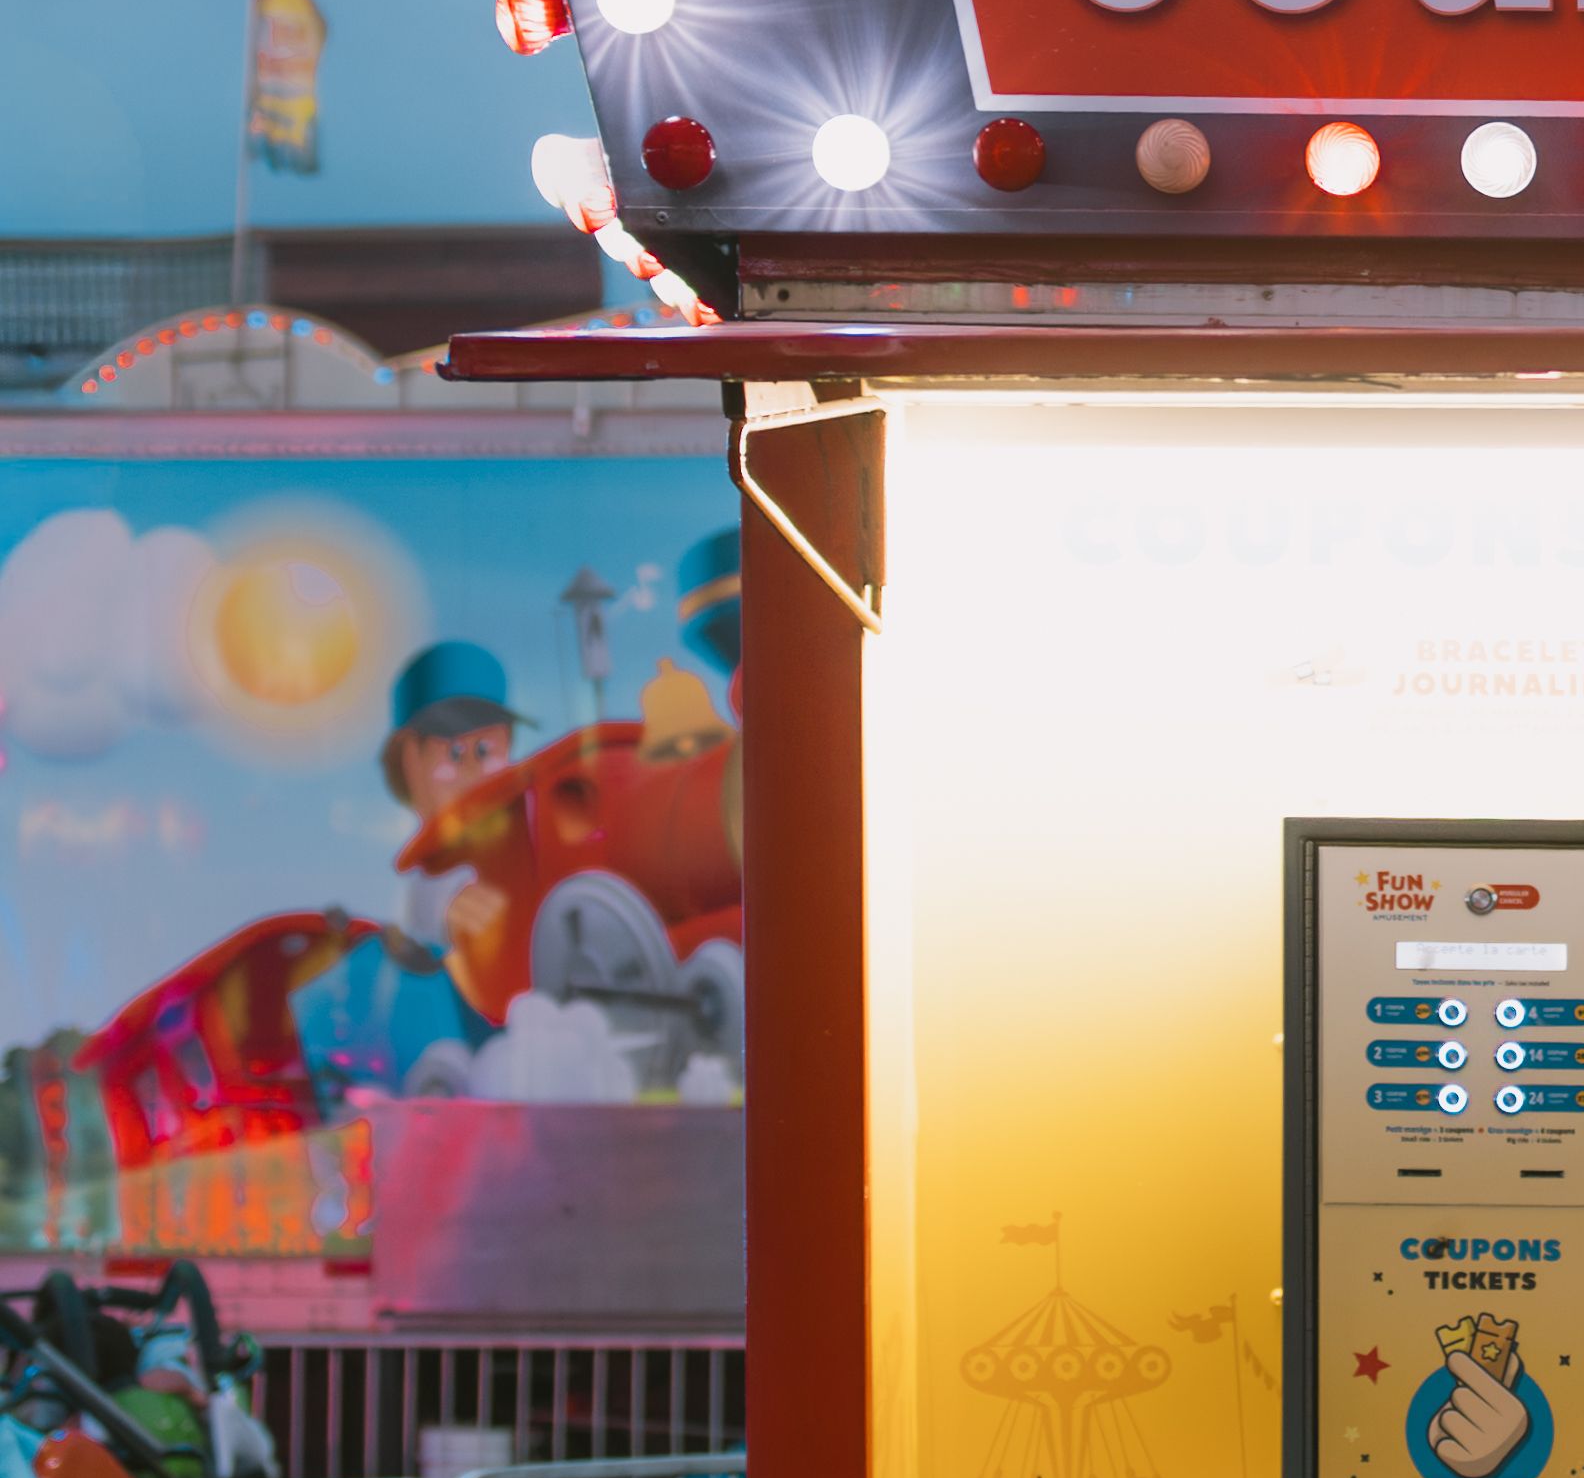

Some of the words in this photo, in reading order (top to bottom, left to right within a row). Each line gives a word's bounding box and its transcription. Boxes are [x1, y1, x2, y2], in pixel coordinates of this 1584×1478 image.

[1376, 870, 1424, 892] FUN
[1365, 891, 1434, 912] SHOW
[1372, 914, 1428, 922] AMUSEMENT
[1373, 1004, 1382, 1017] 1
[1528, 1006, 1538, 1019] 4
[1373, 1046, 1382, 1060] 2
[1529, 1048, 1544, 1062] 14
[1373, 1090, 1382, 1103] 3
[1528, 1092, 1545, 1105] 24
[1400, 1237, 1562, 1262] COUPONS
[1423, 1271, 1538, 1291] TICKETS
